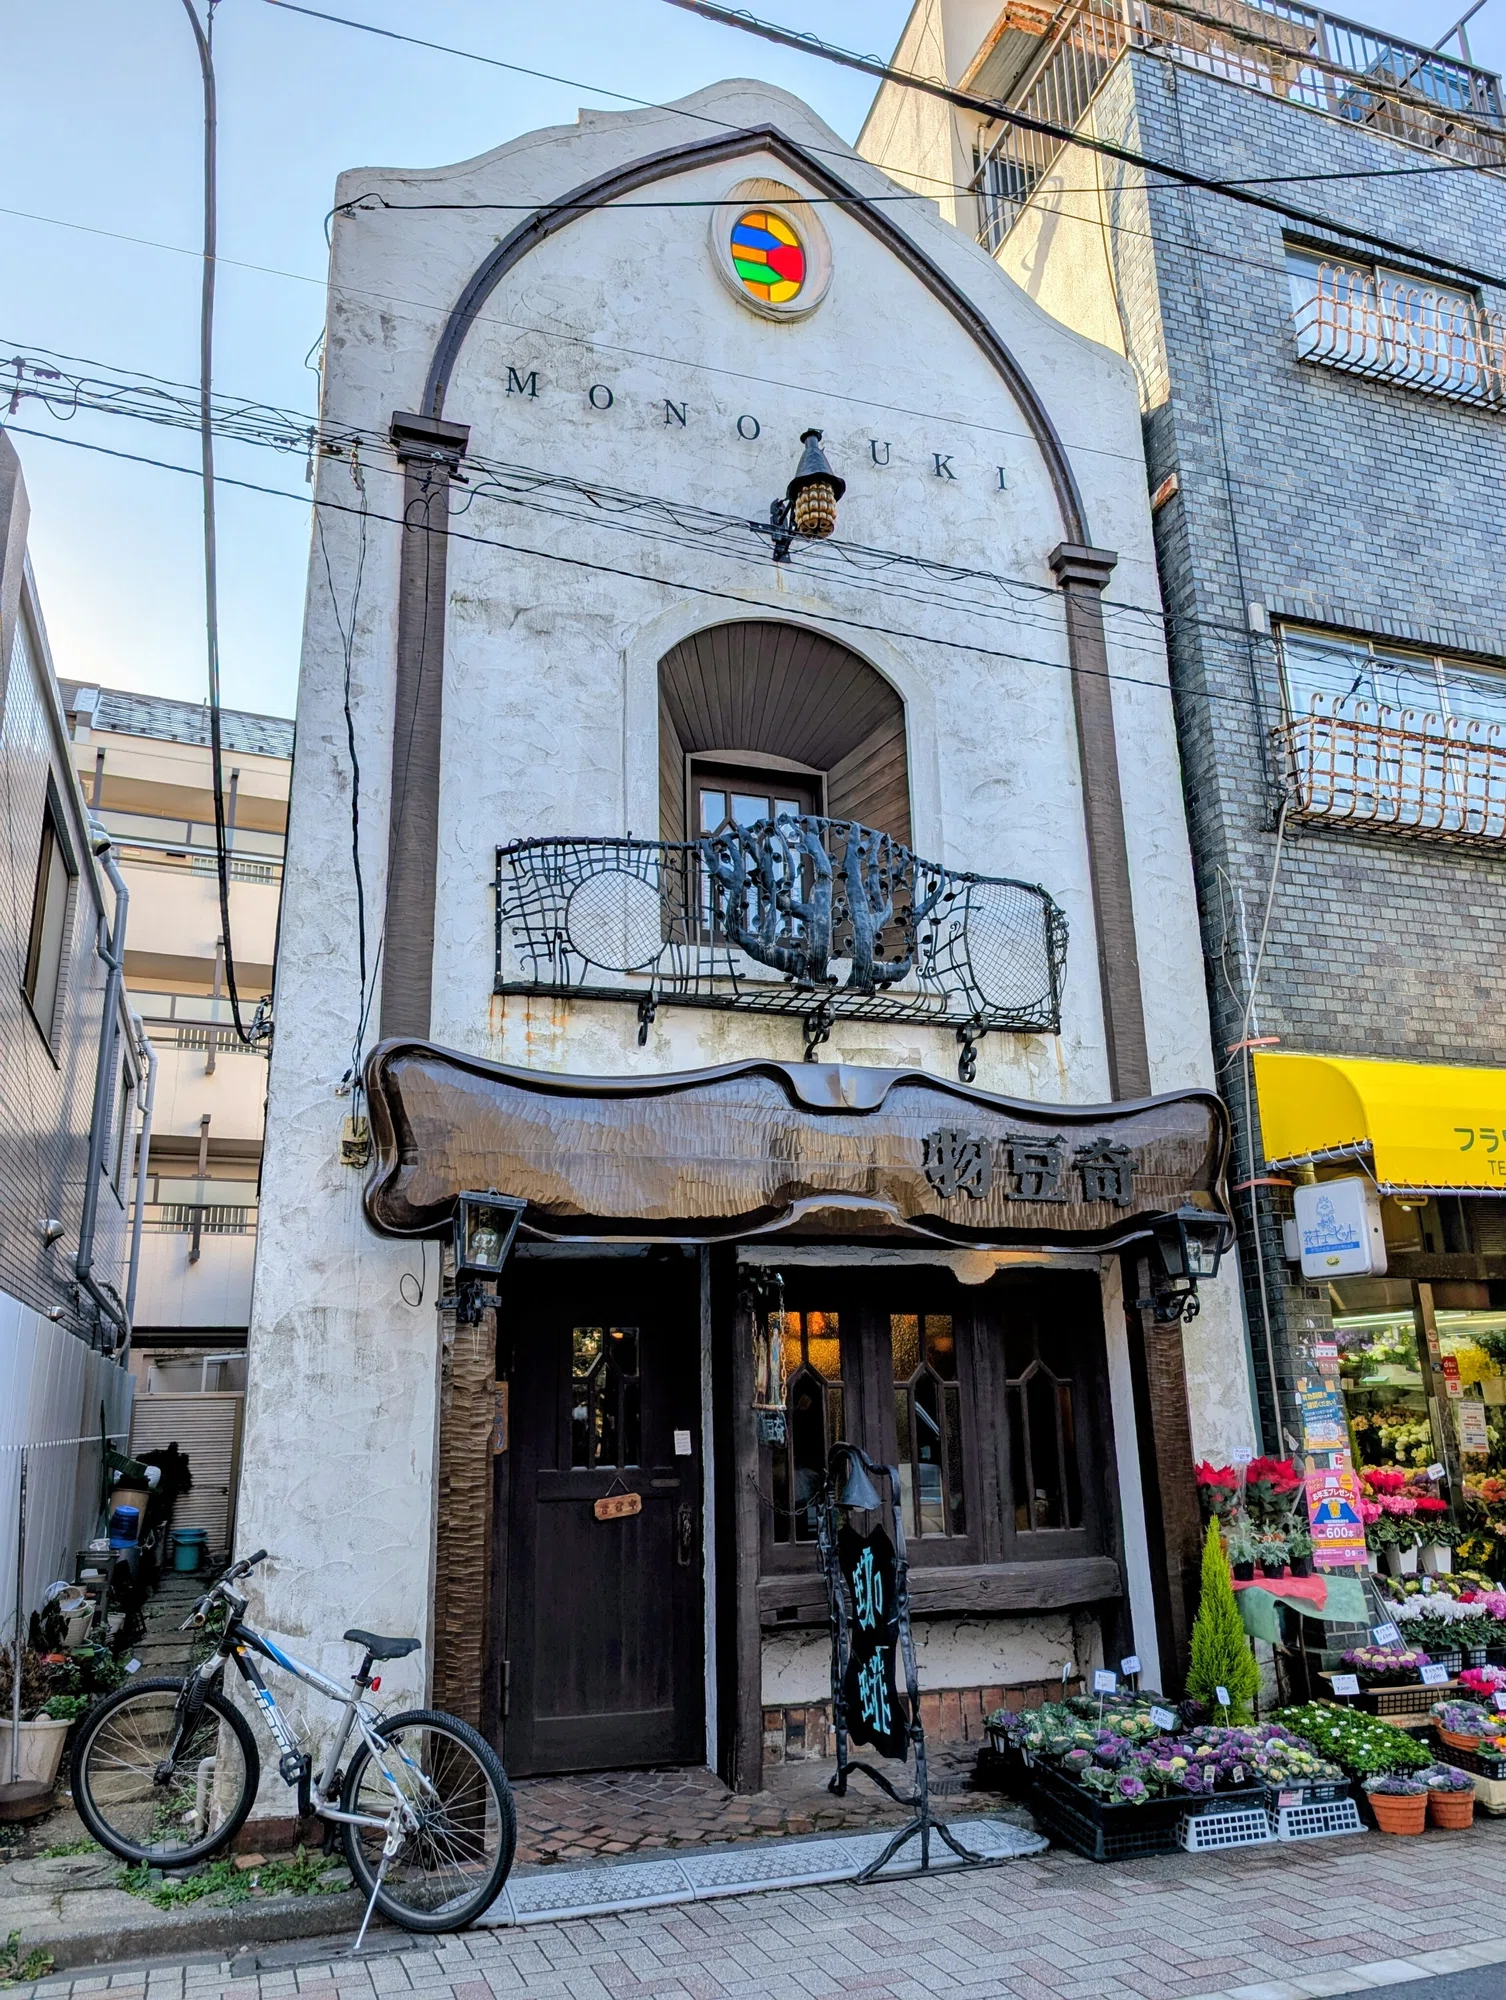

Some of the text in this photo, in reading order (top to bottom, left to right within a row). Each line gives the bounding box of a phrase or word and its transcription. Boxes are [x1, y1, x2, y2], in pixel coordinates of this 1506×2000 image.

[505, 366, 1008, 492] MONOUKI
[1453, 1127, 1506, 1153] フラ
[922, 1127, 1139, 1207] 物豆奇
[1312, 1487, 1355, 1501] お年玉プレゼント
